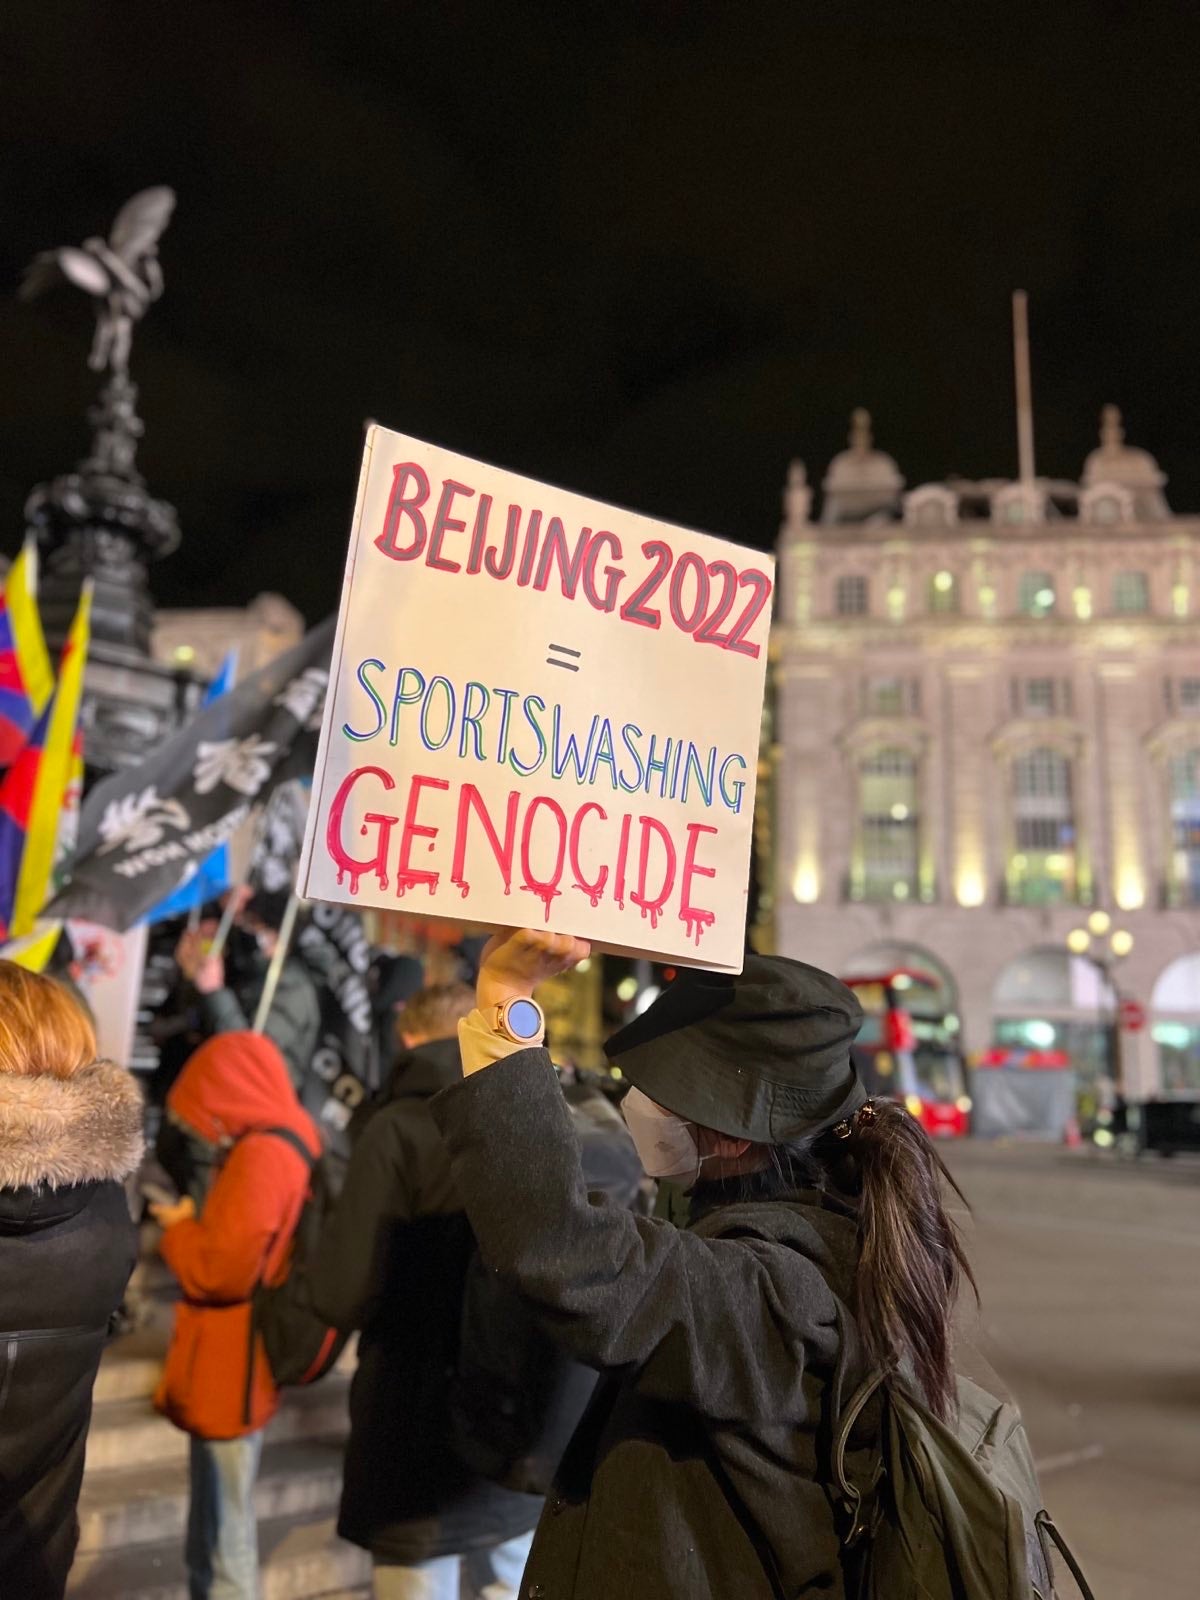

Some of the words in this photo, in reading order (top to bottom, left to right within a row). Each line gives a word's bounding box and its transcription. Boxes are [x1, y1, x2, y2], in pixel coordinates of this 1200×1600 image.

[374, 461, 626, 613] BEIJING
[620, 539, 773, 659] 2022
[342, 657, 748, 814] SPORTSWASHING
[326, 765, 719, 946] GENOCIDE
